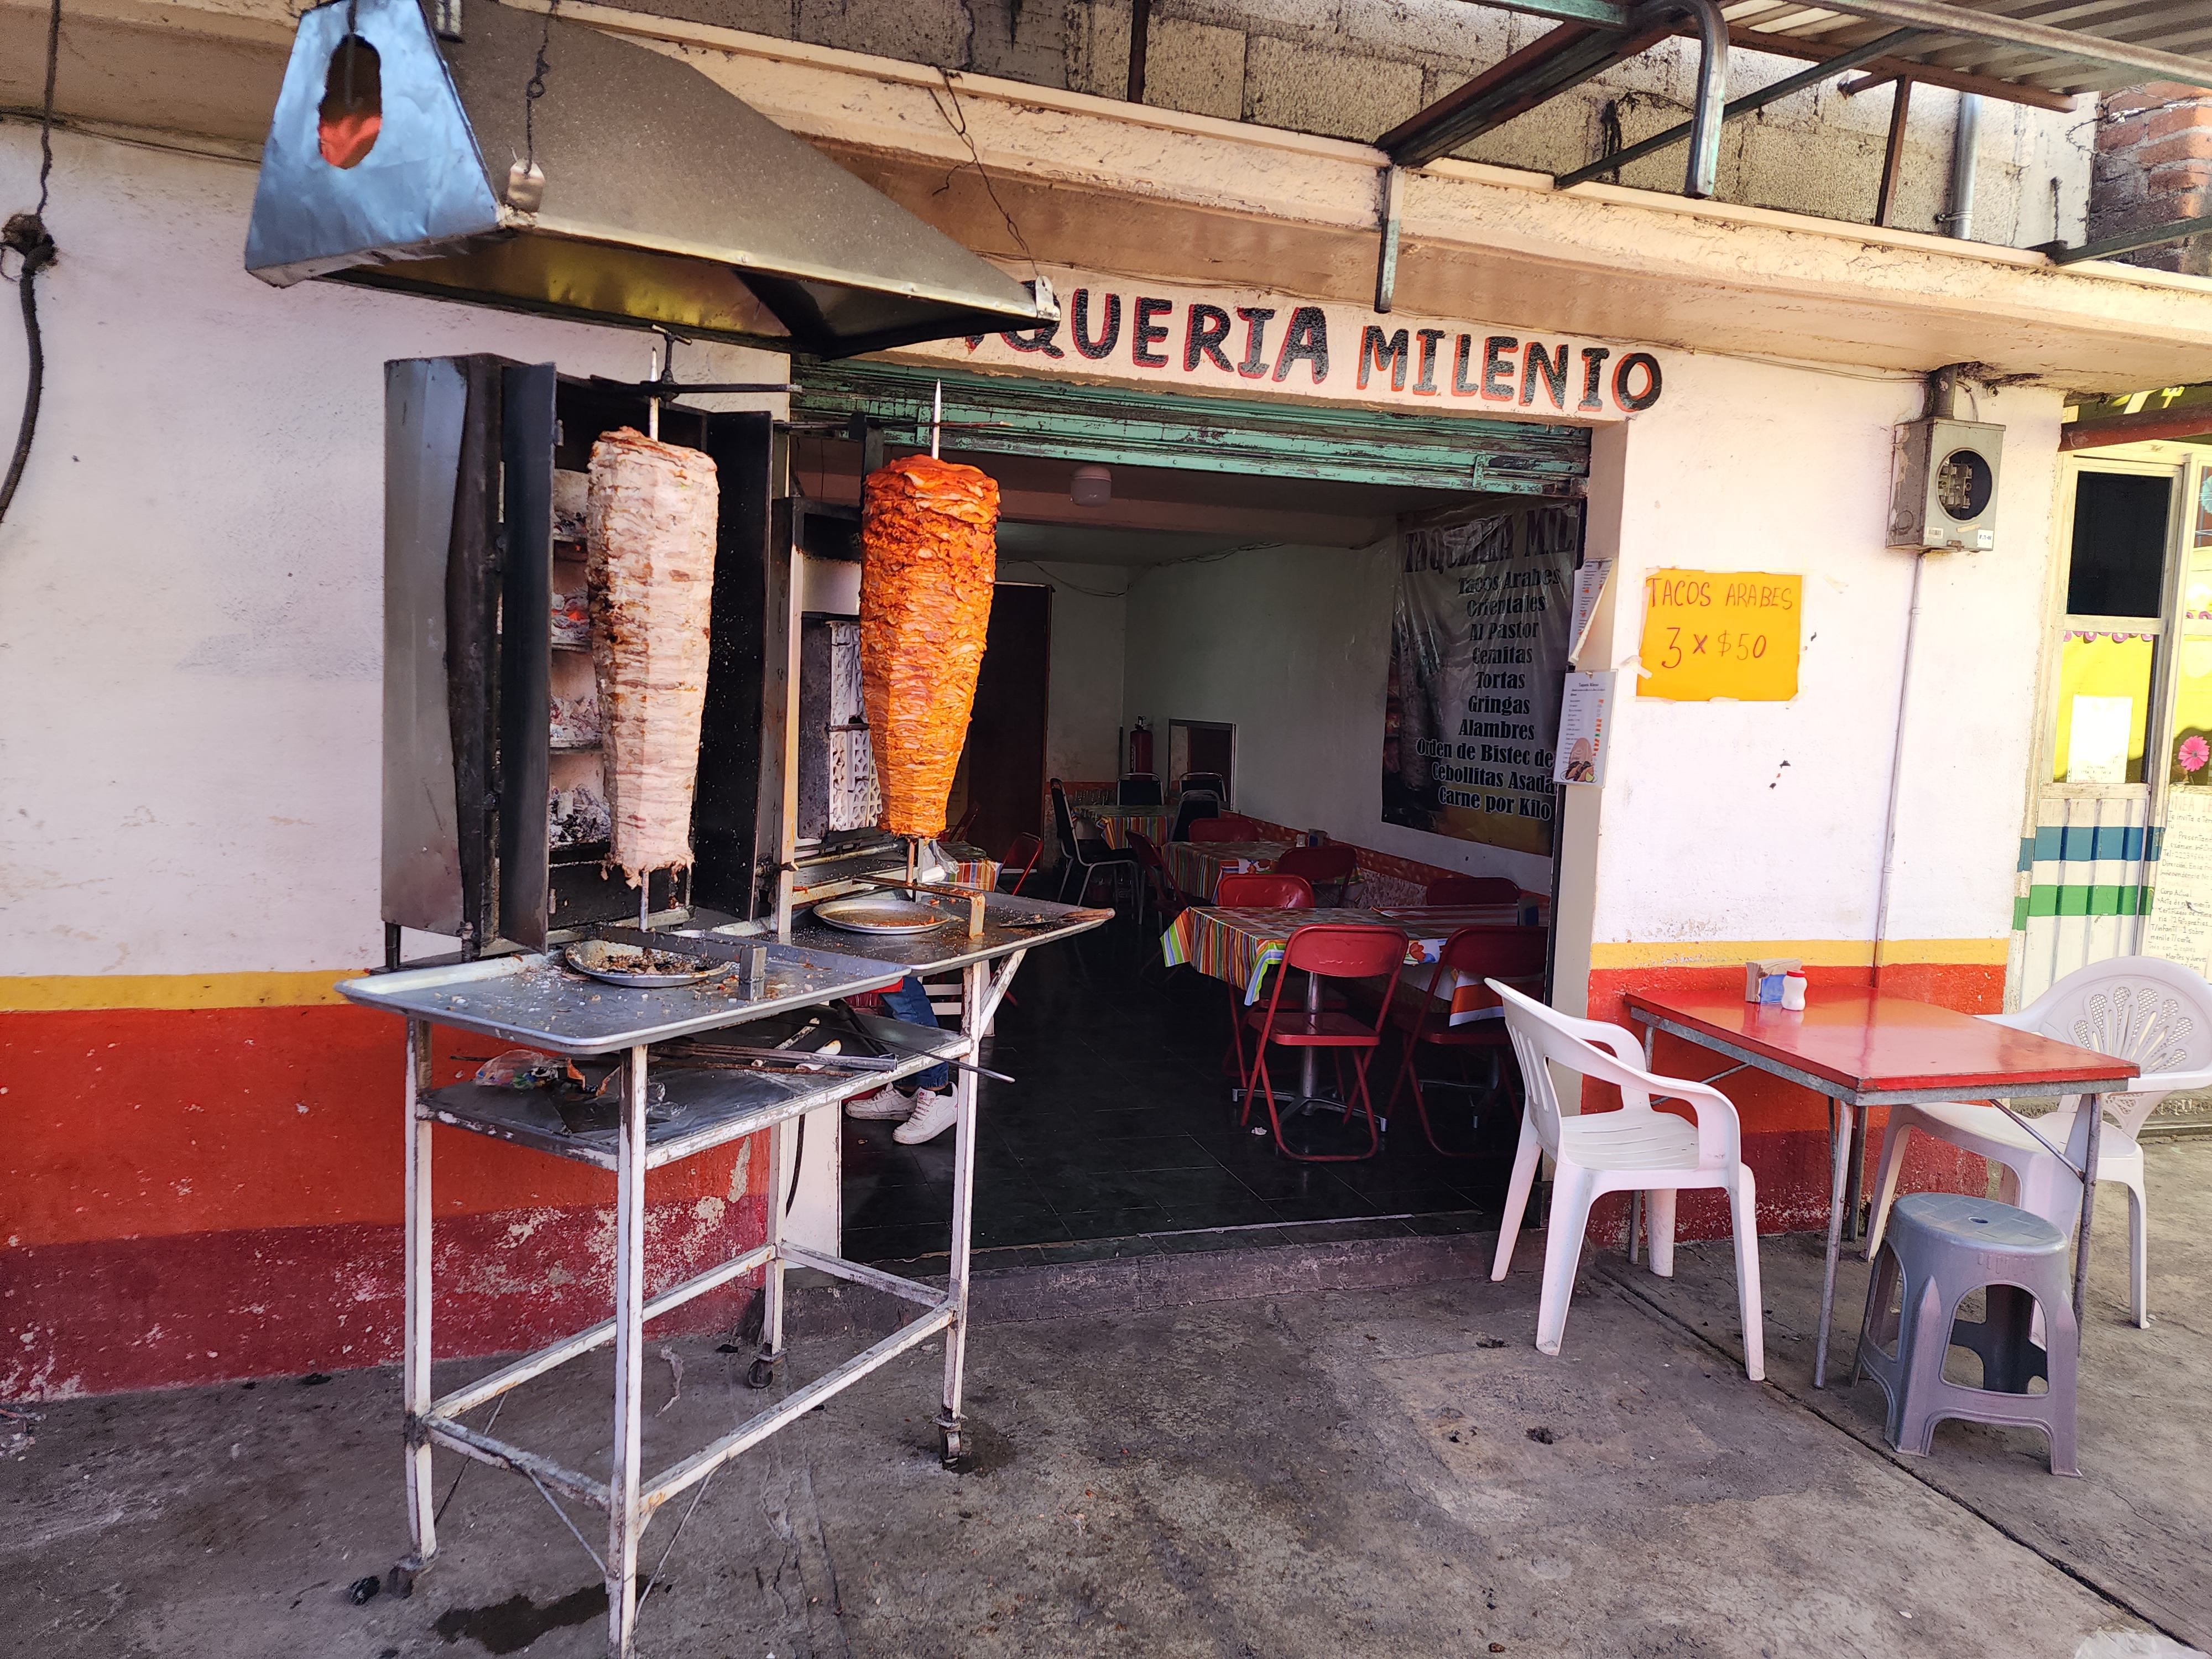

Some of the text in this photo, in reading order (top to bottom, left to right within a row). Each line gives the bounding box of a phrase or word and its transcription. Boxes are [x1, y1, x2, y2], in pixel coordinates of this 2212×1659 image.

[965, 279, 1662, 413] QUERIA MILENIO
[1458, 576, 1498, 595] Tacos
[1504, 568, 1561, 589] Arabes
[1646, 577, 1793, 610] TACOS ARABES
[1467, 594, 1547, 617] Orientales
[1469, 620, 1539, 641] Al Pastor
[1472, 646, 1532, 664] Cemitas
[1661, 627, 1682, 669] 3
[1717, 629, 1767, 661] $50
[1475, 671, 1526, 689] Tortas
[1468, 695, 1530, 716] Gringas
[1458, 719, 1535, 740] Alambres
[1416, 738, 1452, 758] Orden
[1457, 743, 1475, 760] de
[1480, 744, 1530, 765] Bistec
[1432, 762, 1557, 795] Cebollitas Asada
[1439, 787, 1552, 821] Carne por Kilo
